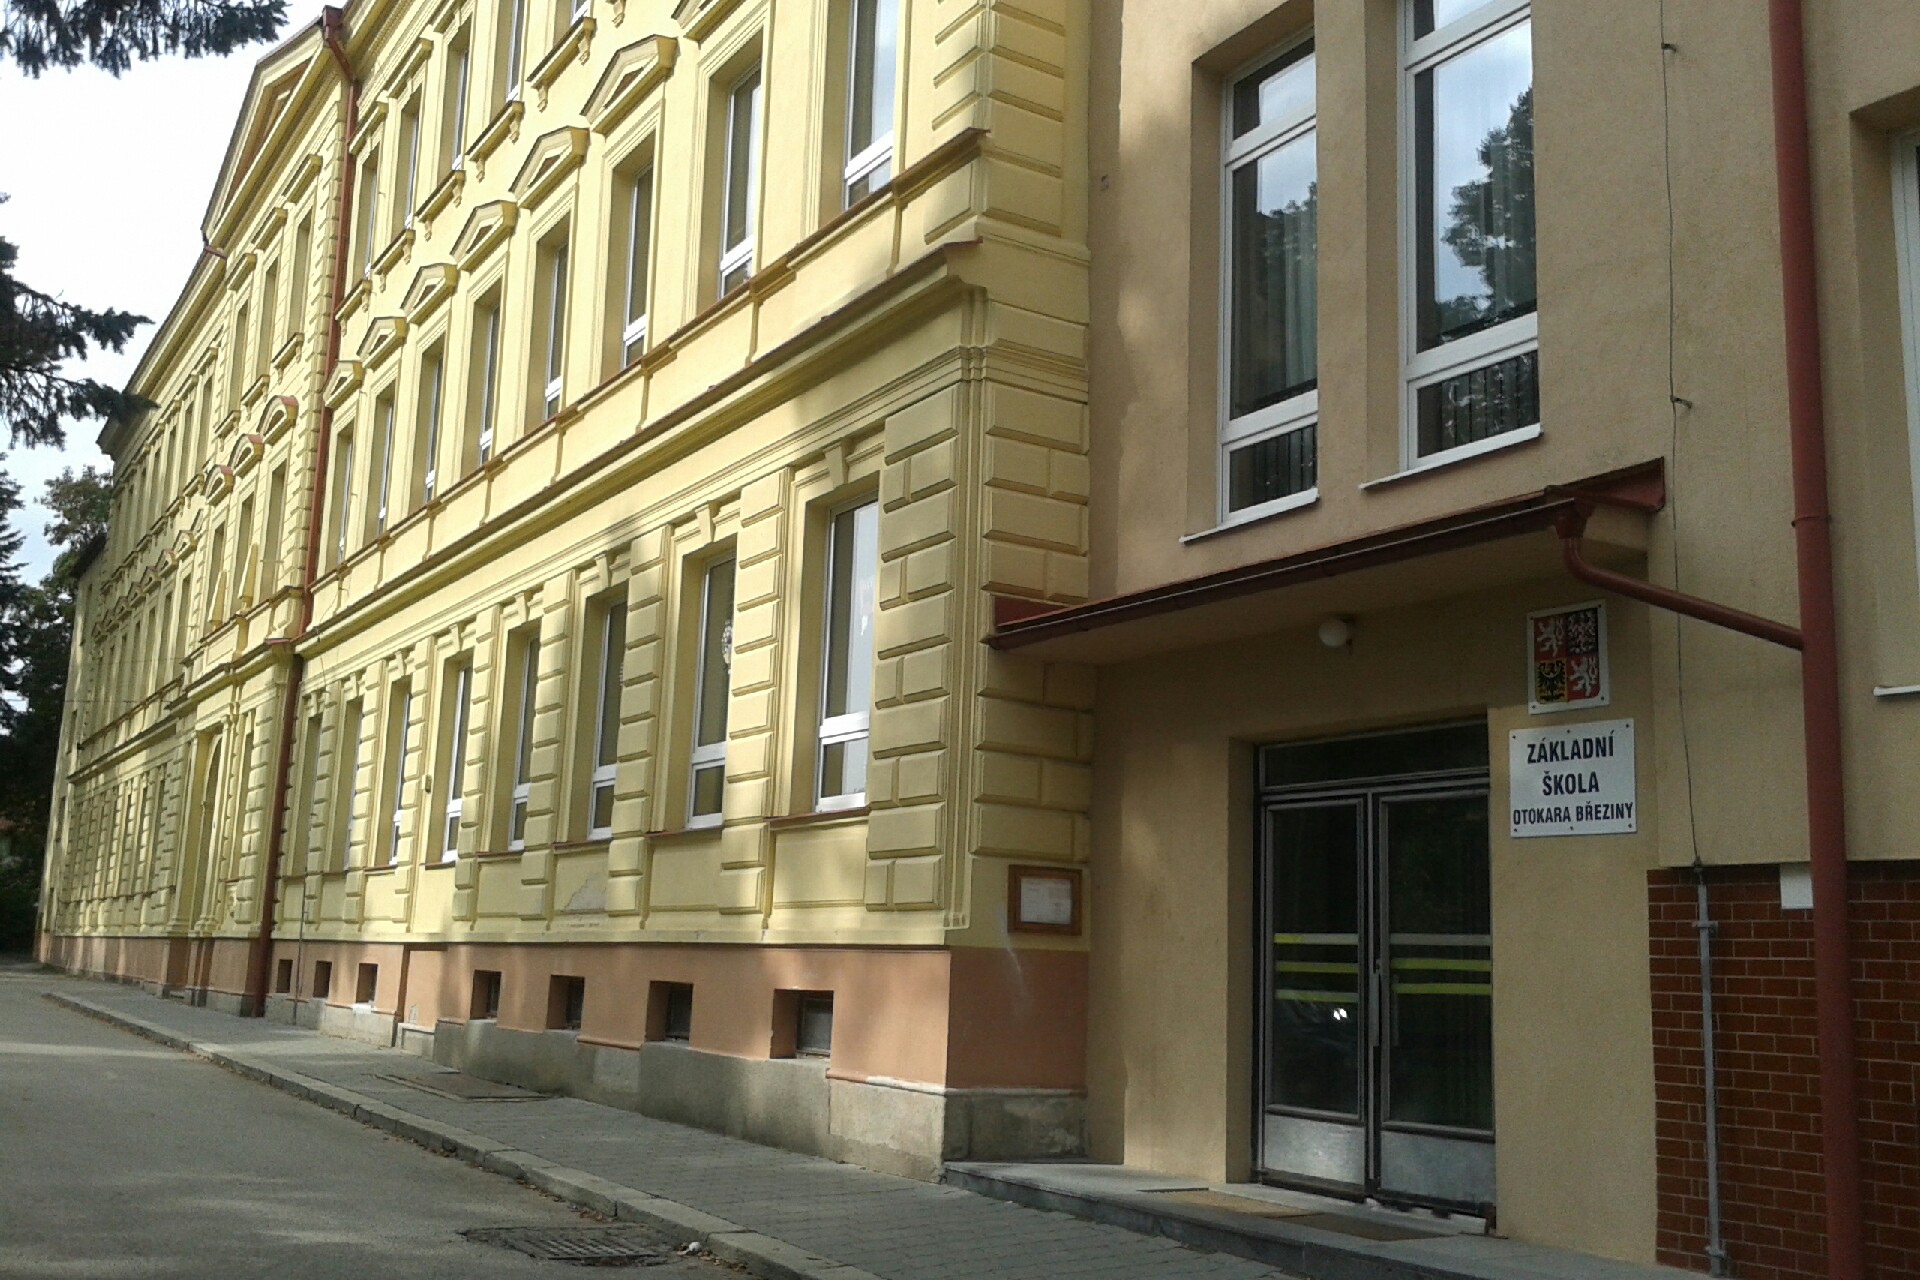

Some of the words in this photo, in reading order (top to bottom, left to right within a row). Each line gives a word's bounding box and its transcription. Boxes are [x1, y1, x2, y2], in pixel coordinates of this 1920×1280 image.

[1527, 729, 1615, 764] ZÁKLADNÍ
[1542, 770, 1600, 796] ŠKOLA
[1513, 806, 1571, 825] OTOKARA
[1575, 801, 1633, 822] BŘEZINY
